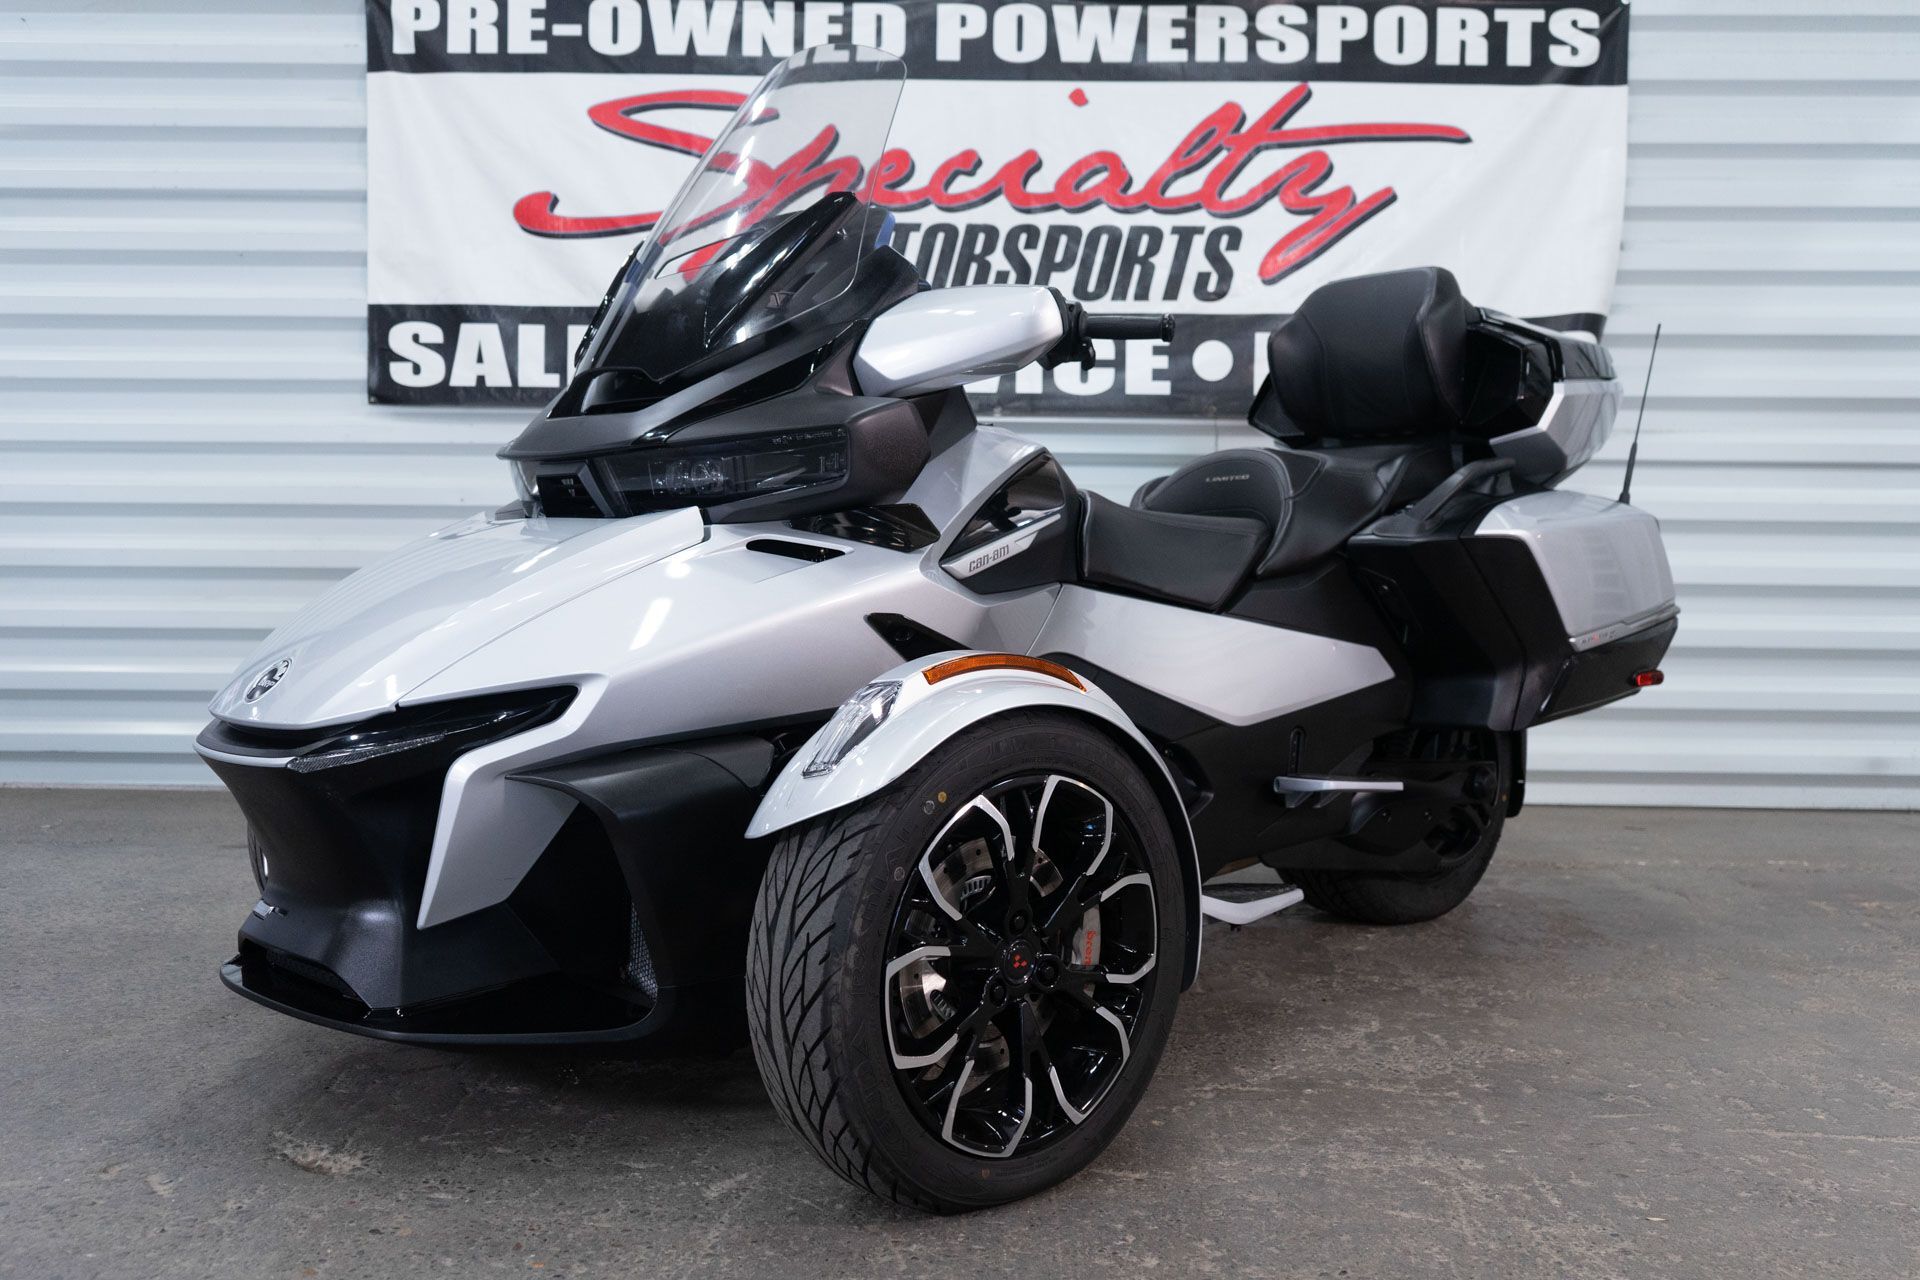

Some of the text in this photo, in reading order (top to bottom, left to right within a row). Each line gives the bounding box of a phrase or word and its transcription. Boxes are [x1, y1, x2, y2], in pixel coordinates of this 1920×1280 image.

[391, 0, 1603, 68] PRE-OWNED POWERSPORTS
[513, 82, 1472, 286] Specialty
[968, 544, 1010, 573] can-am
